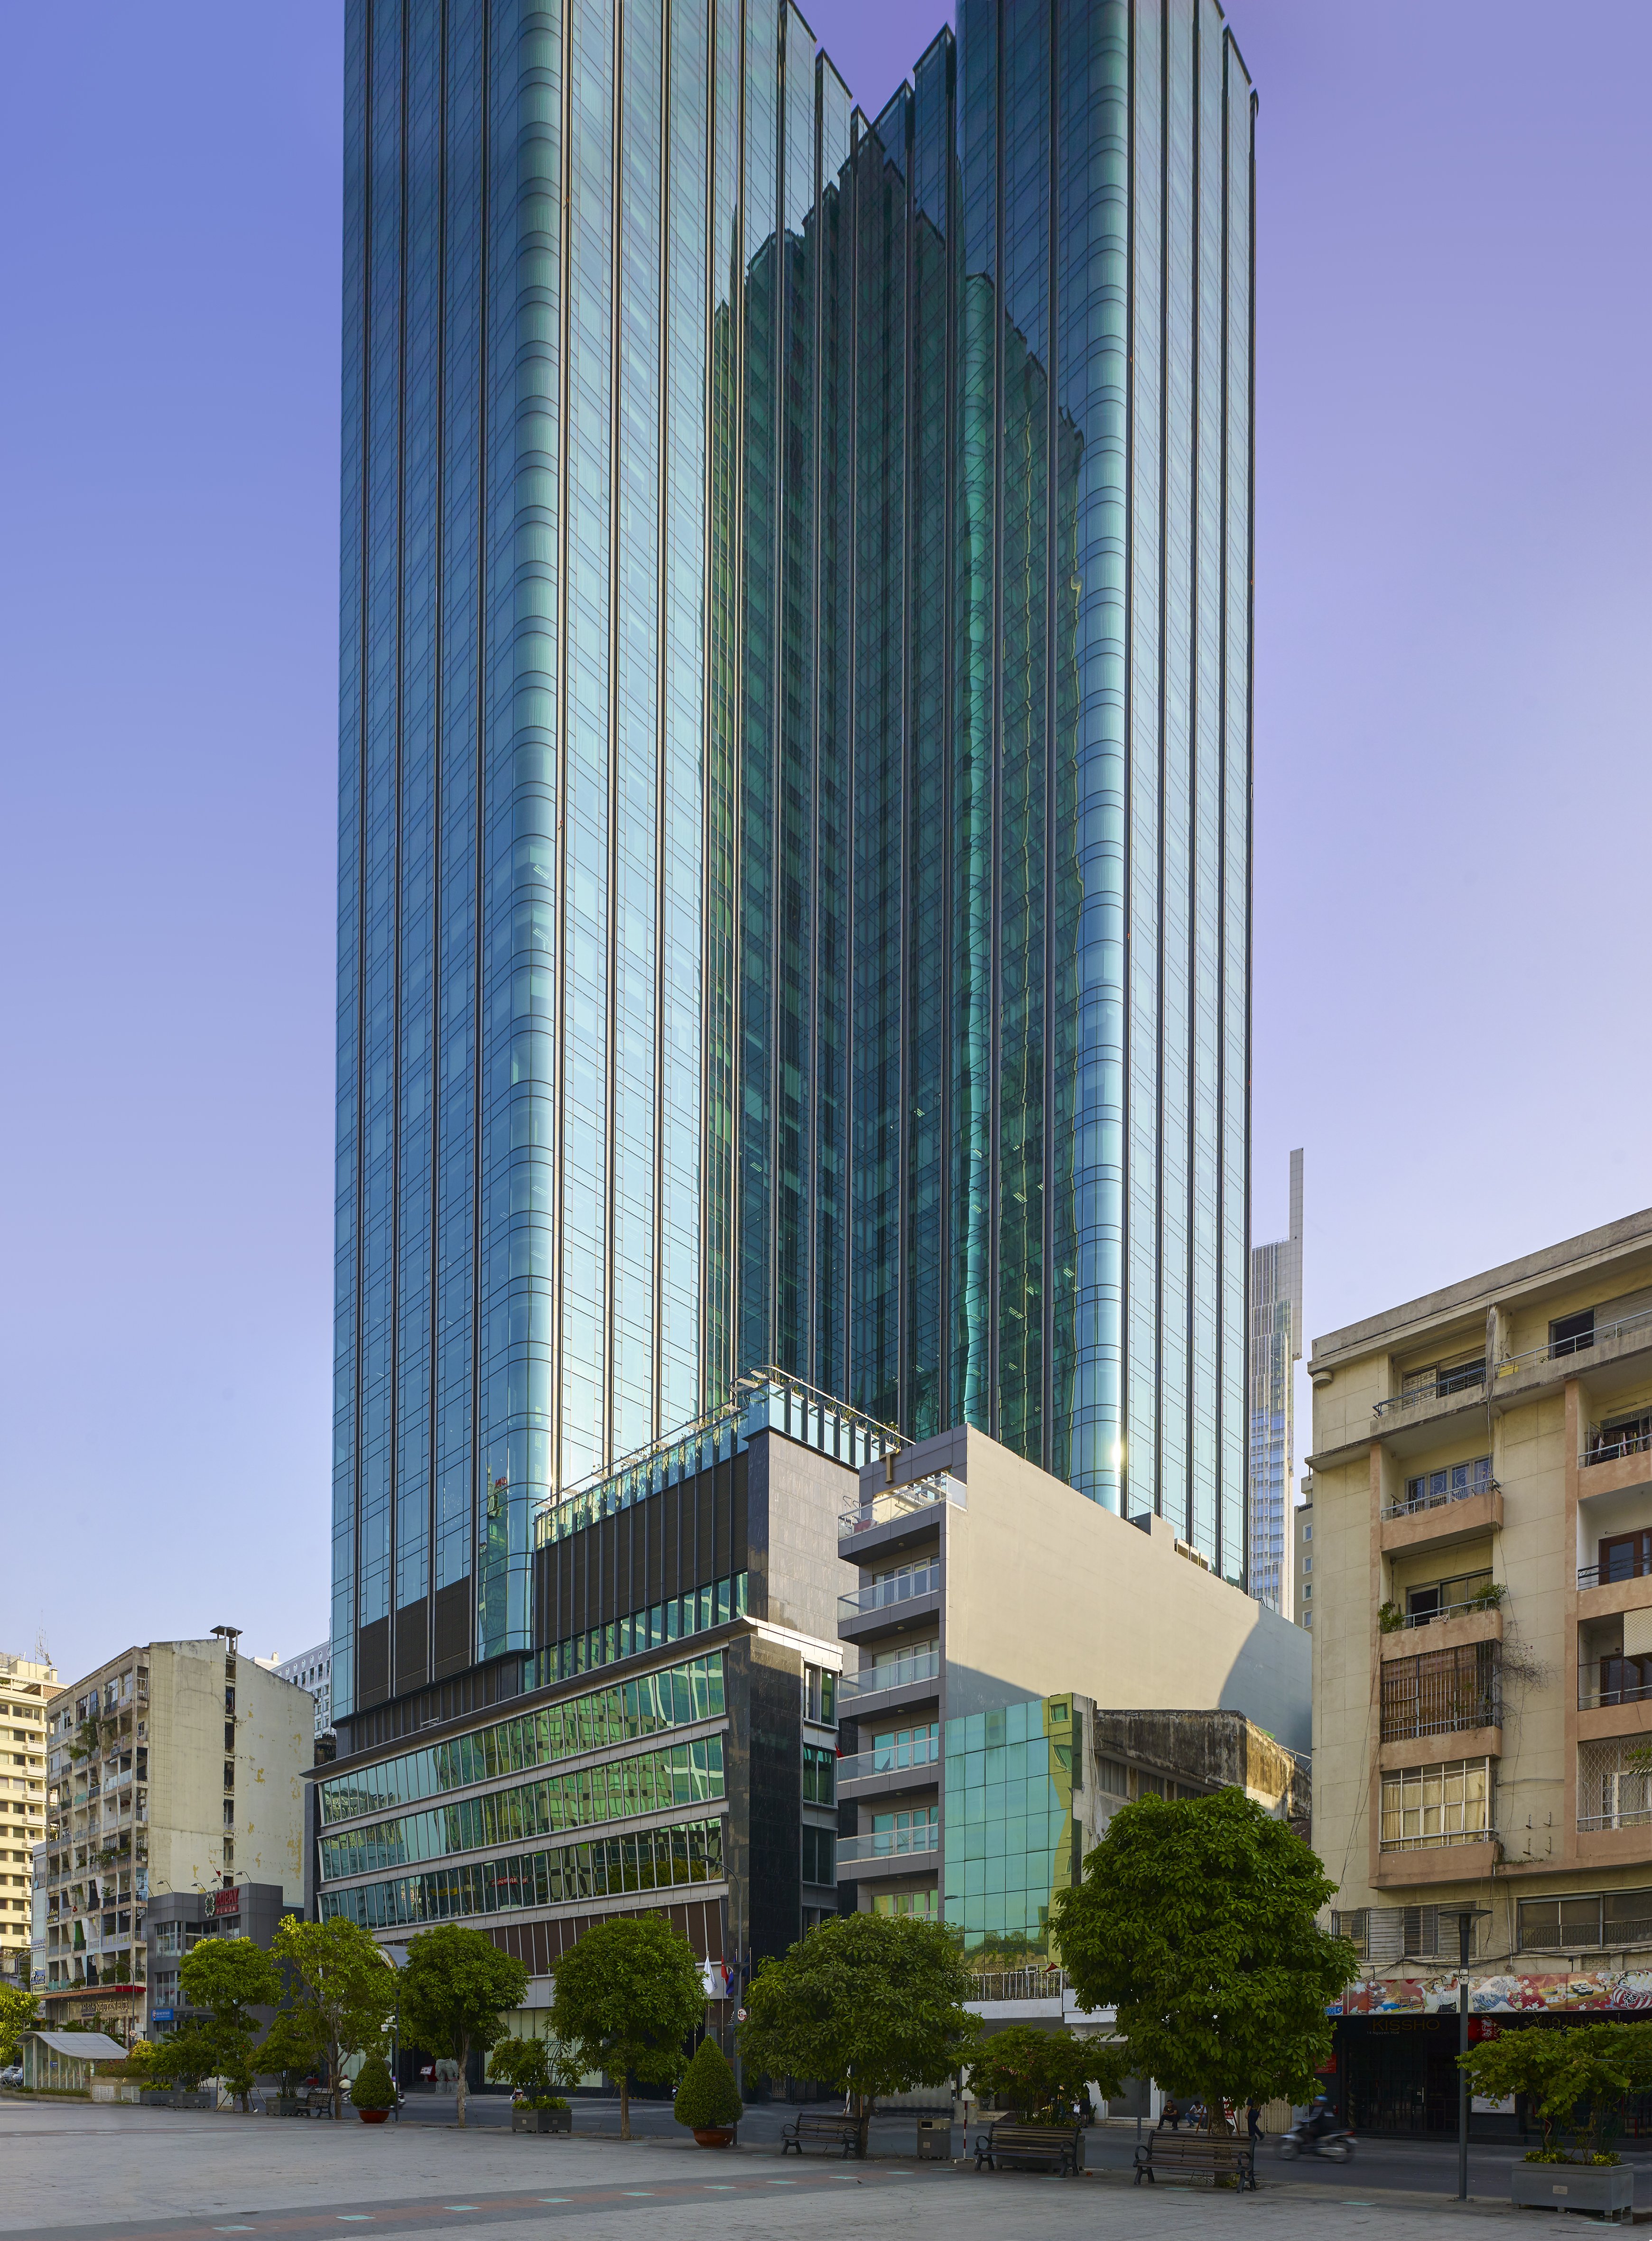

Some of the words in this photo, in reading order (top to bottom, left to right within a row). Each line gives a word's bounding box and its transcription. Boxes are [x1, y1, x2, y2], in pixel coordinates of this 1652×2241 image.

[216, 1888, 239, 1906] LUCKY
[217, 1906, 236, 1914] PLAZA
[1373, 2019, 1440, 2031] KISSHO
